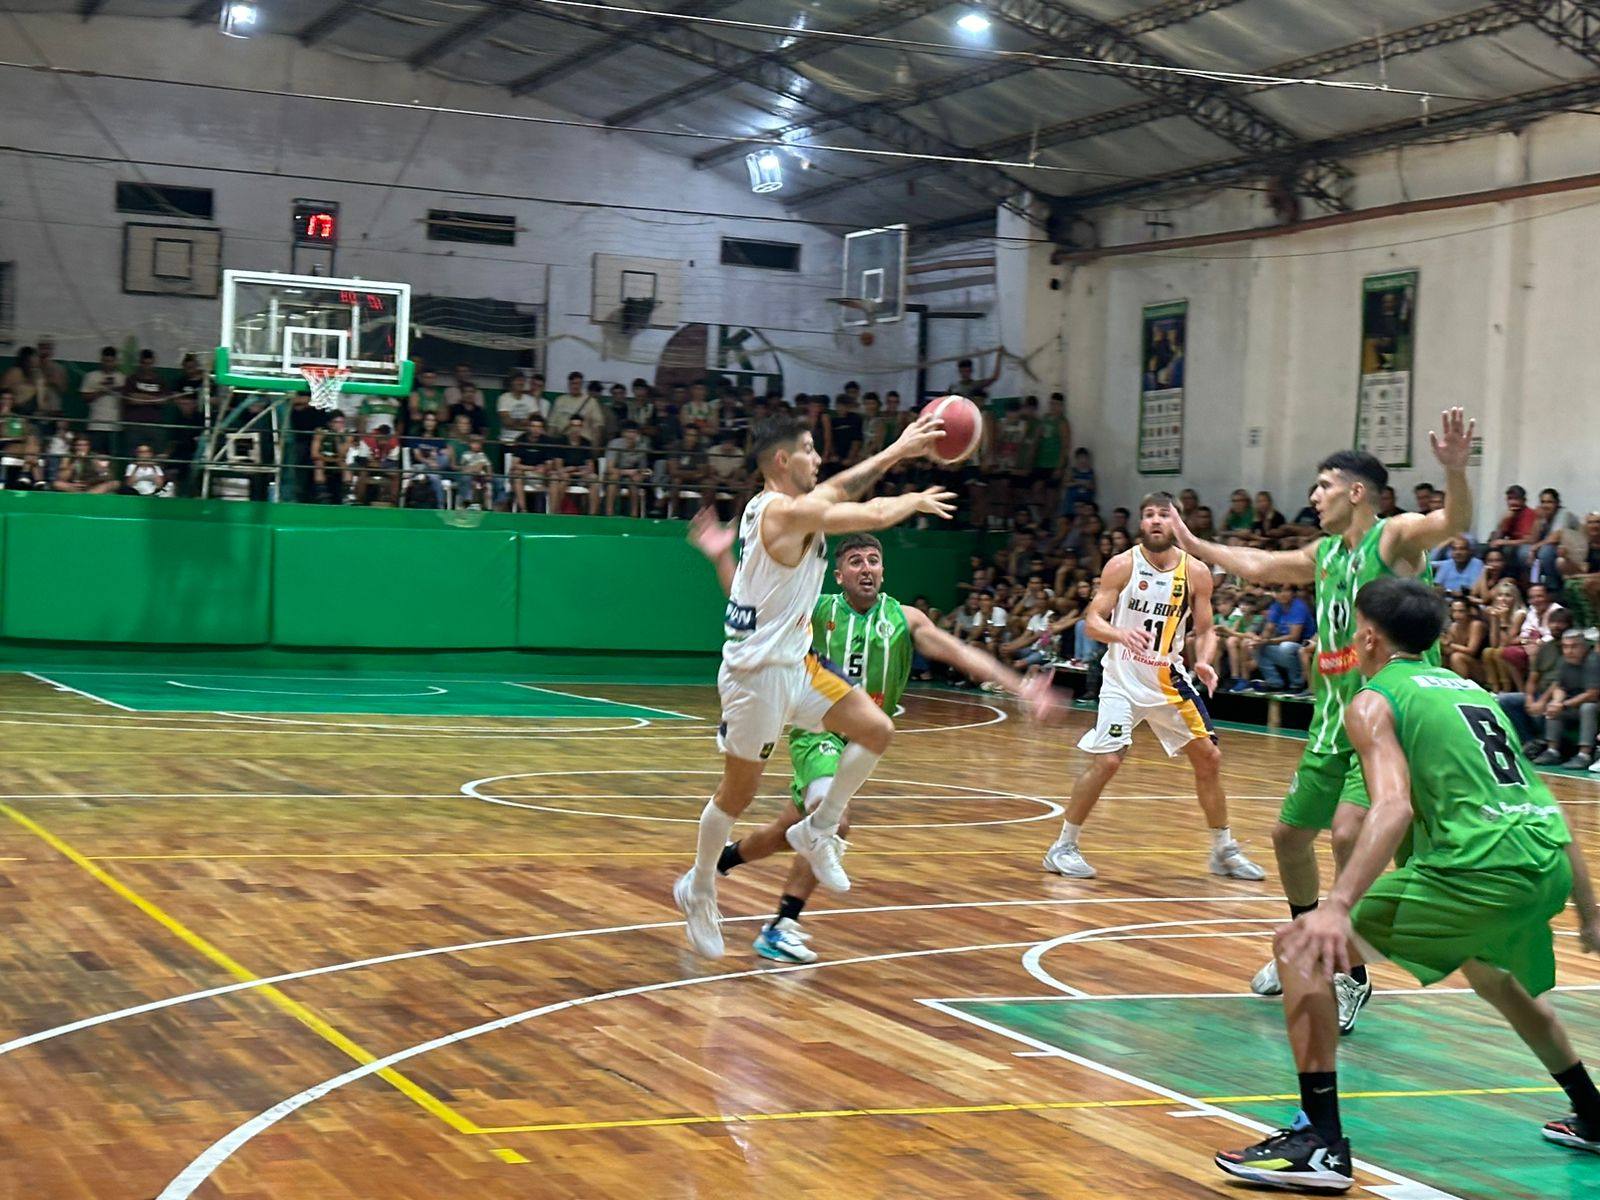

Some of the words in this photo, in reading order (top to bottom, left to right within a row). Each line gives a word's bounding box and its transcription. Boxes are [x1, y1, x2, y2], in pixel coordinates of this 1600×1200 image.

[306, 213, 333, 238] 17
[1143, 619, 1164, 651] 11
[848, 653, 863, 677] 5
[1456, 704, 1527, 786] 8
